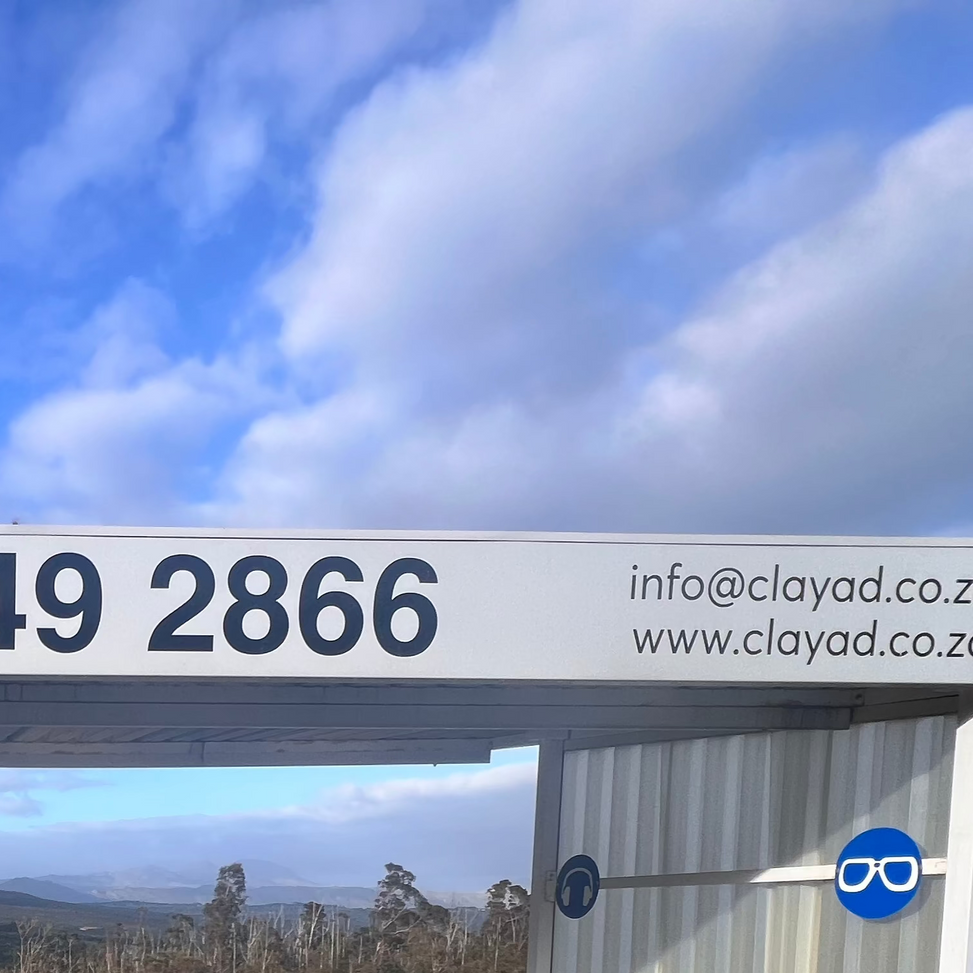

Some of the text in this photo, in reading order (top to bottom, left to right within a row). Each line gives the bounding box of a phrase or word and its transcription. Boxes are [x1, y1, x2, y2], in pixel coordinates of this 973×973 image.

[147, 554, 439, 657] 2866
[630, 562, 973, 611] info@clayad.co.z
[632, 618, 973, 665] www.clayad.co.z
